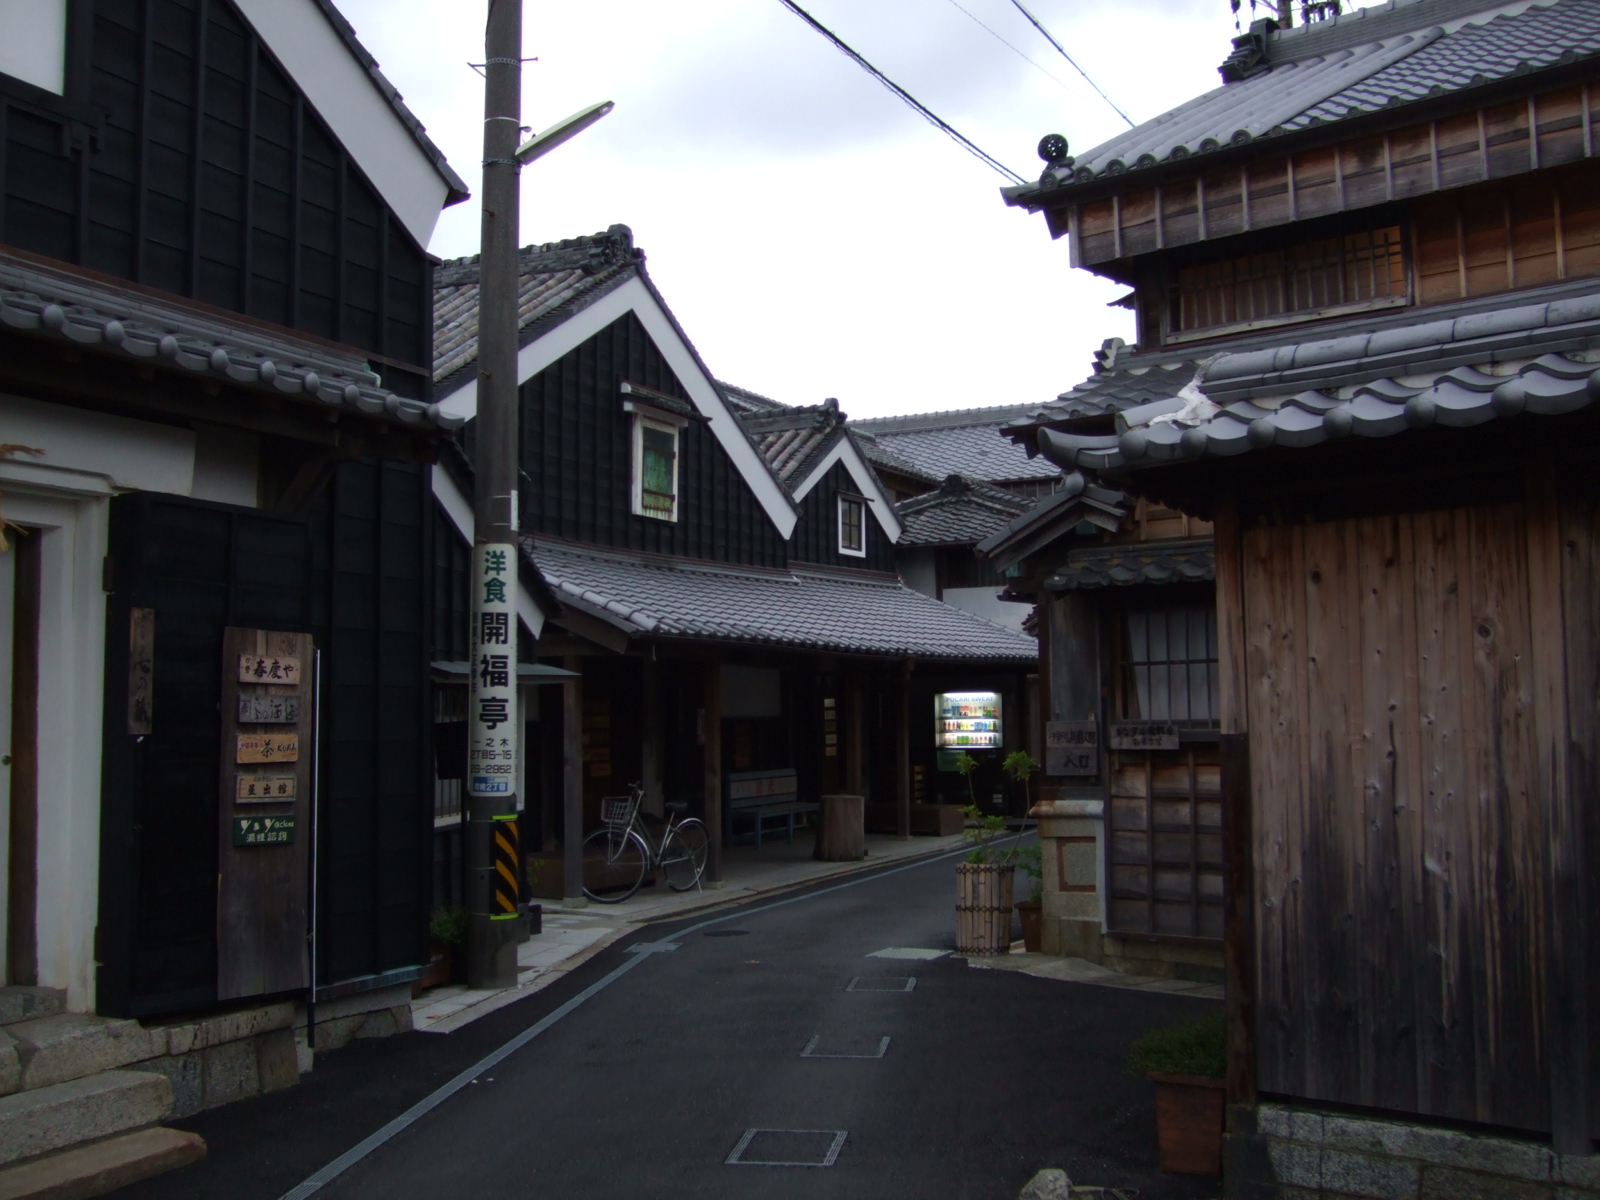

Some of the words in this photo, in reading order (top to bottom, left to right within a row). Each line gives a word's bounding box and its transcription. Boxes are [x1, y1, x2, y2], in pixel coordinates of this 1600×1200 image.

[484, 550, 507, 604] 洋食
[253, 658, 294, 680] 春慶や
[480, 612, 509, 730] 開福亭
[474, 737, 509, 748] 一之木
[471, 750, 512, 760] 2丁目5-15
[1062, 754, 1089, 769] 入口
[470, 764, 512, 774] 28-2952
